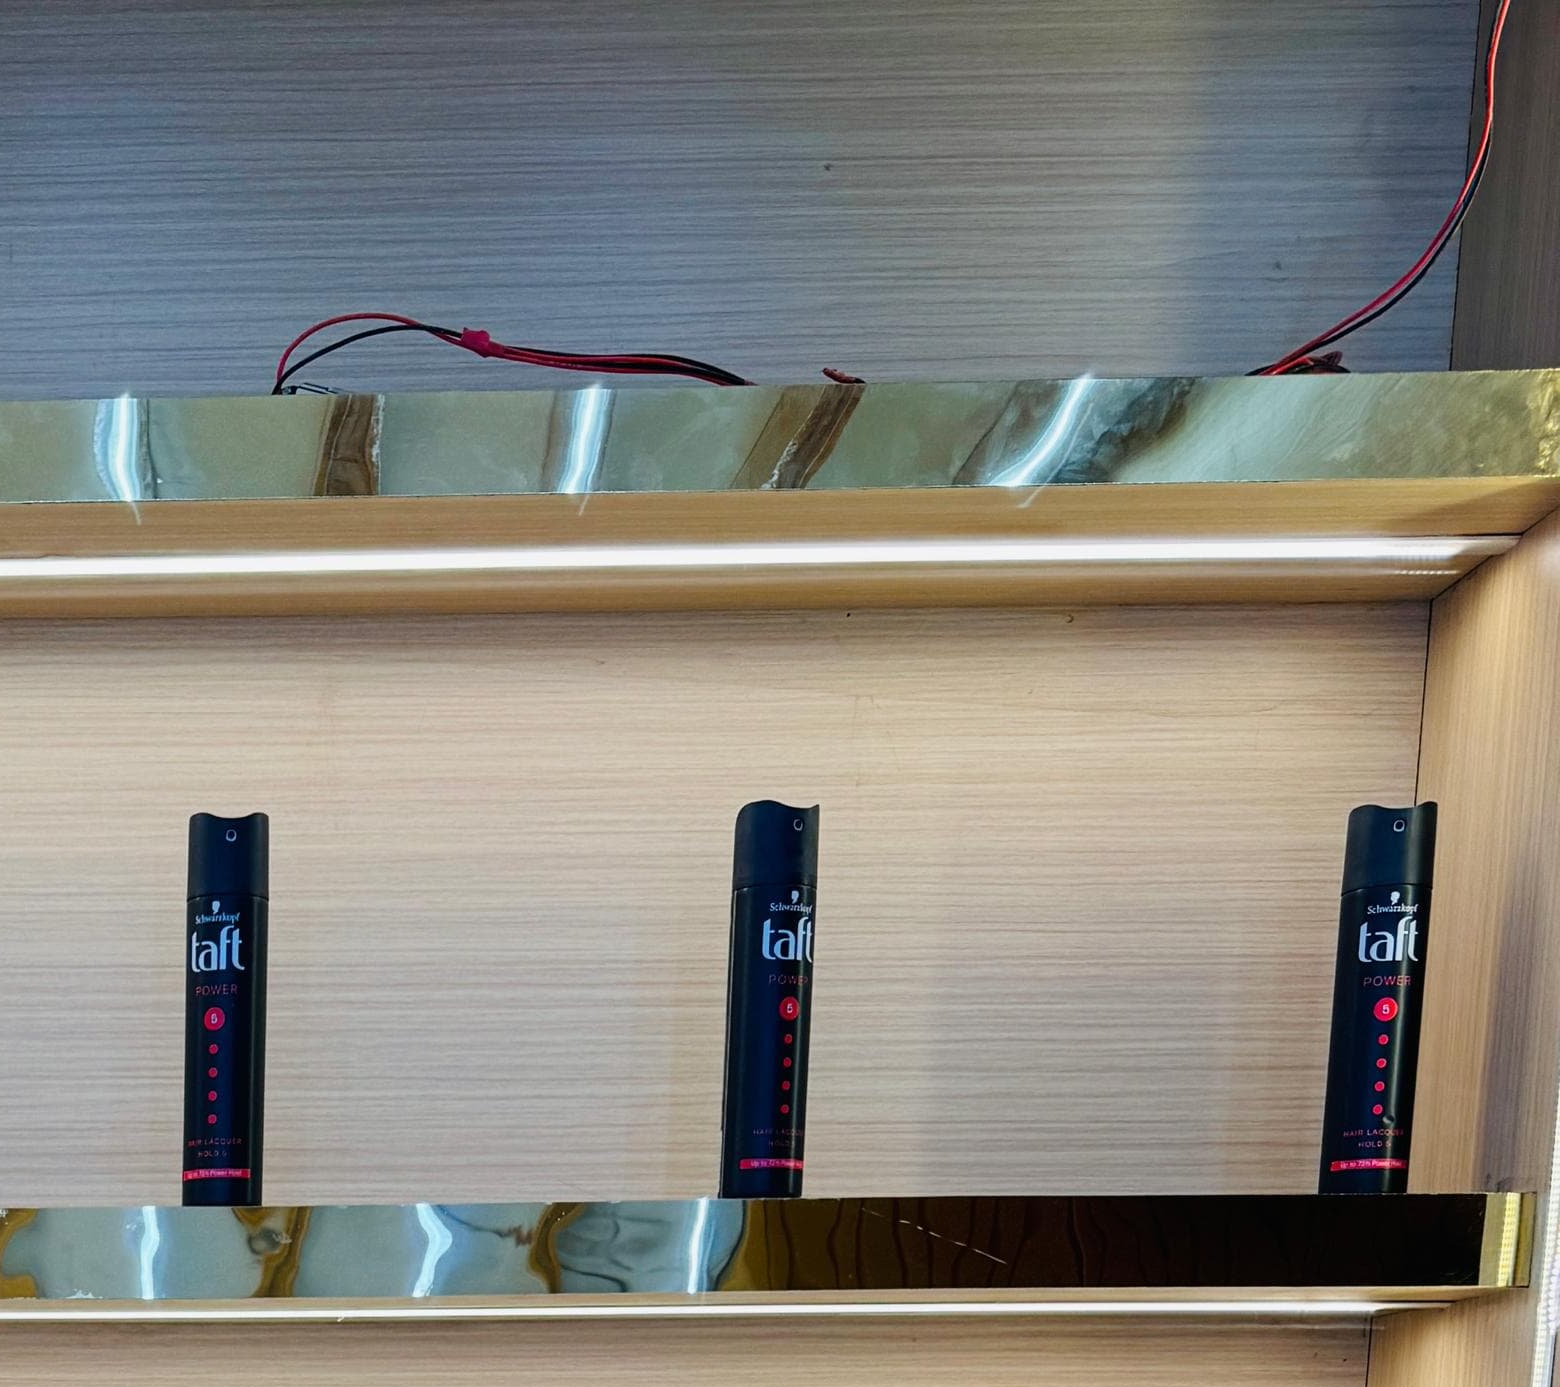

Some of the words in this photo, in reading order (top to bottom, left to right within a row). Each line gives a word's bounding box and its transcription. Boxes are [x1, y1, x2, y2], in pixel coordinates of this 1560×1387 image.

[1367, 903, 1419, 915] Schwarzkopf
[191, 925, 245, 972] taft
[762, 917, 813, 963] taft
[1358, 916, 1419, 963] taft
[1363, 975, 1411, 987] POWER
